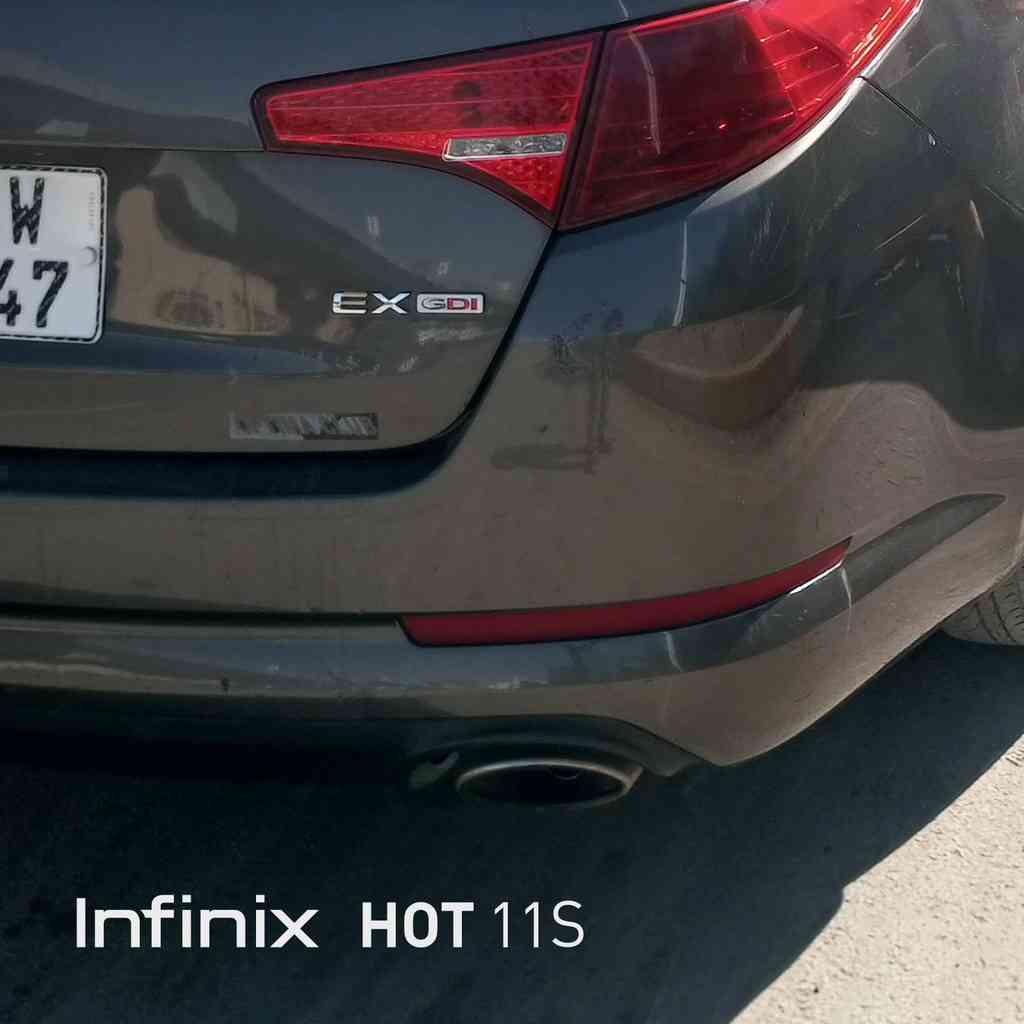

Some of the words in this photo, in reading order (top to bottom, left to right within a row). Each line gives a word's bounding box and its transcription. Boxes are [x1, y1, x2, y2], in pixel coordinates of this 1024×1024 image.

[9, 177, 45, 245] W
[332, 292, 411, 314] EX
[421, 297, 480, 311] GDI
